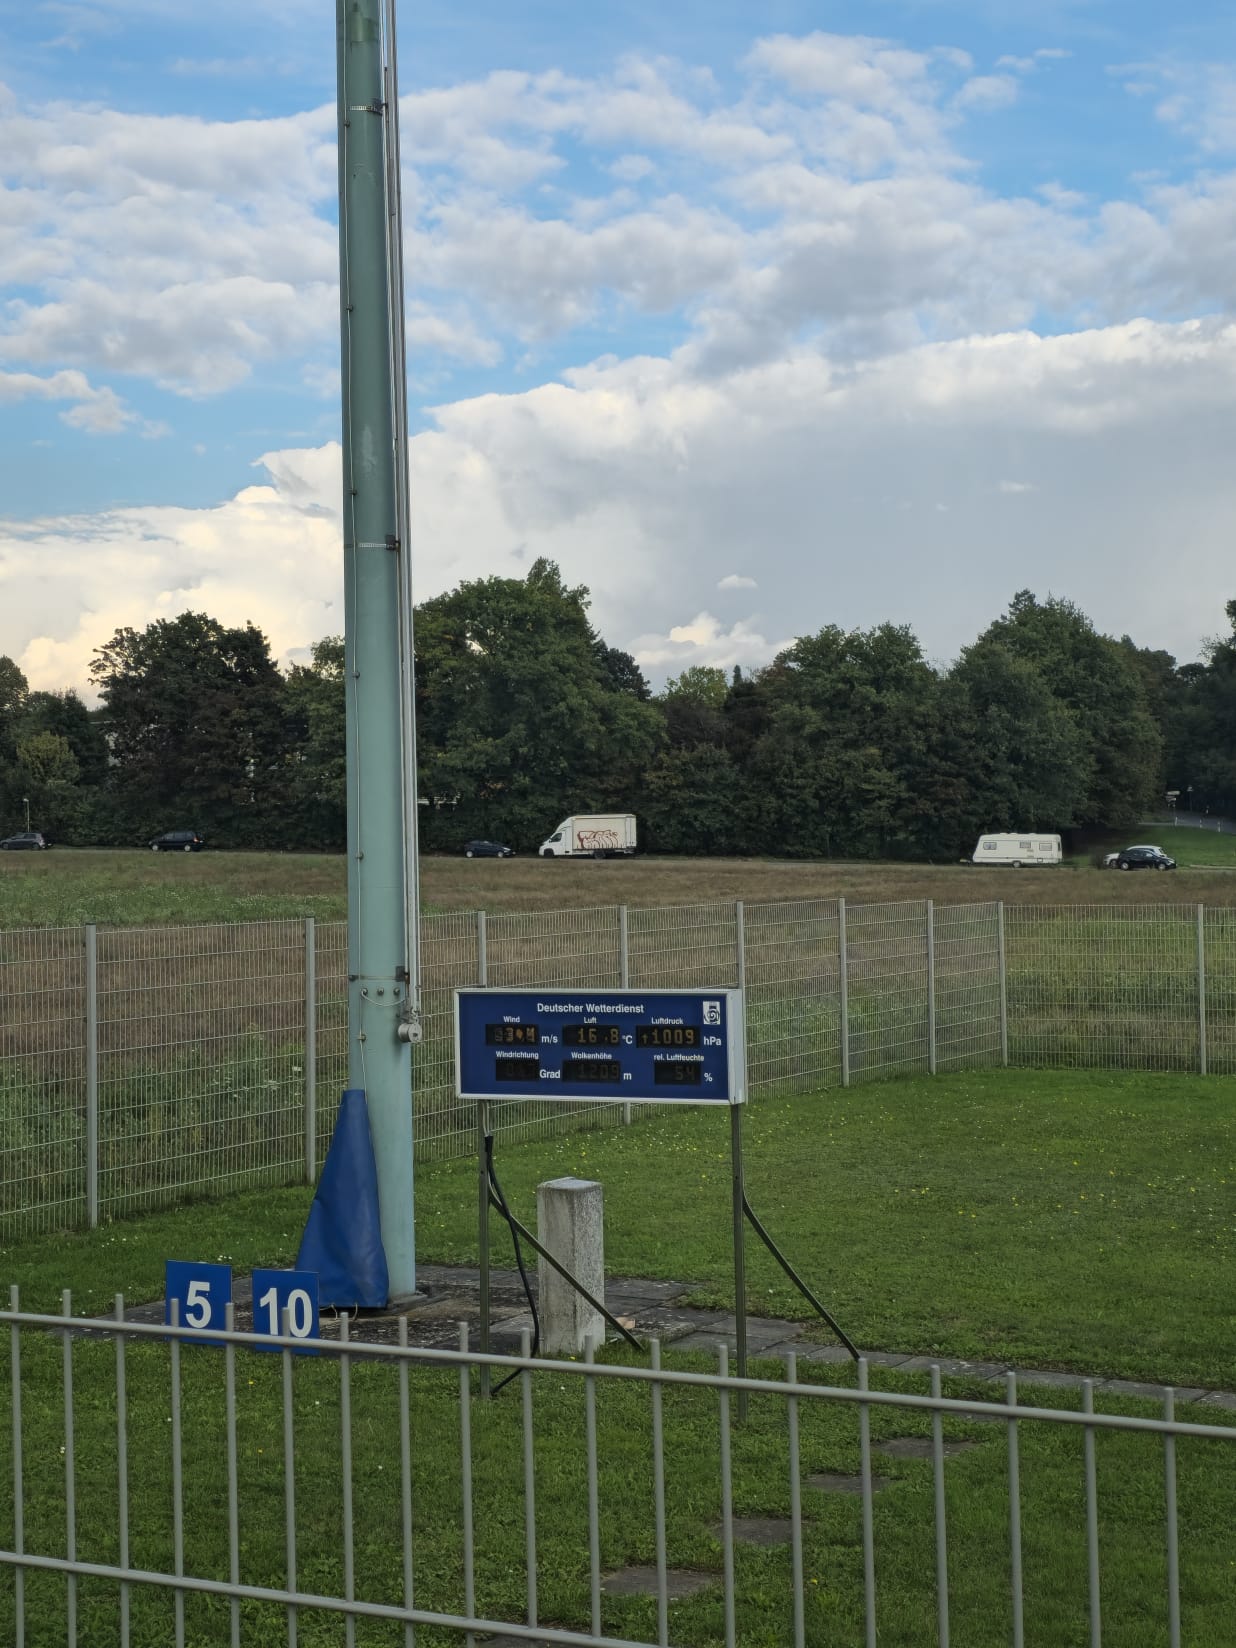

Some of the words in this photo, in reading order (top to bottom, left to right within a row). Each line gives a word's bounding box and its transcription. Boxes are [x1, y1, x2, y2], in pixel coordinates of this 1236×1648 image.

[537, 1003, 583, 1013] Deutscher
[585, 1003, 644, 1014] Wetterdienst
[503, 1015, 520, 1023] Wind
[583, 1016, 597, 1024] Luft
[651, 1017, 684, 1025] Luftdruck
[541, 1034, 558, 1044] m/s
[622, 1035, 633, 1045] °C
[652, 1029, 694, 1045] 1009
[703, 1036, 722, 1046] hPa
[496, 1050, 539, 1059] Windrichtung
[571, 1051, 612, 1060] Wolkenhöhe
[653, 1053, 665, 1061] rel.
[667, 1053, 705, 1062] Luftfeuchte
[539, 1069, 561, 1079] Grad
[623, 1072, 632, 1080] m
[704, 1072, 713, 1082] %
[185, 1280, 212, 1329] 5
[260, 1287, 313, 1338] 10
